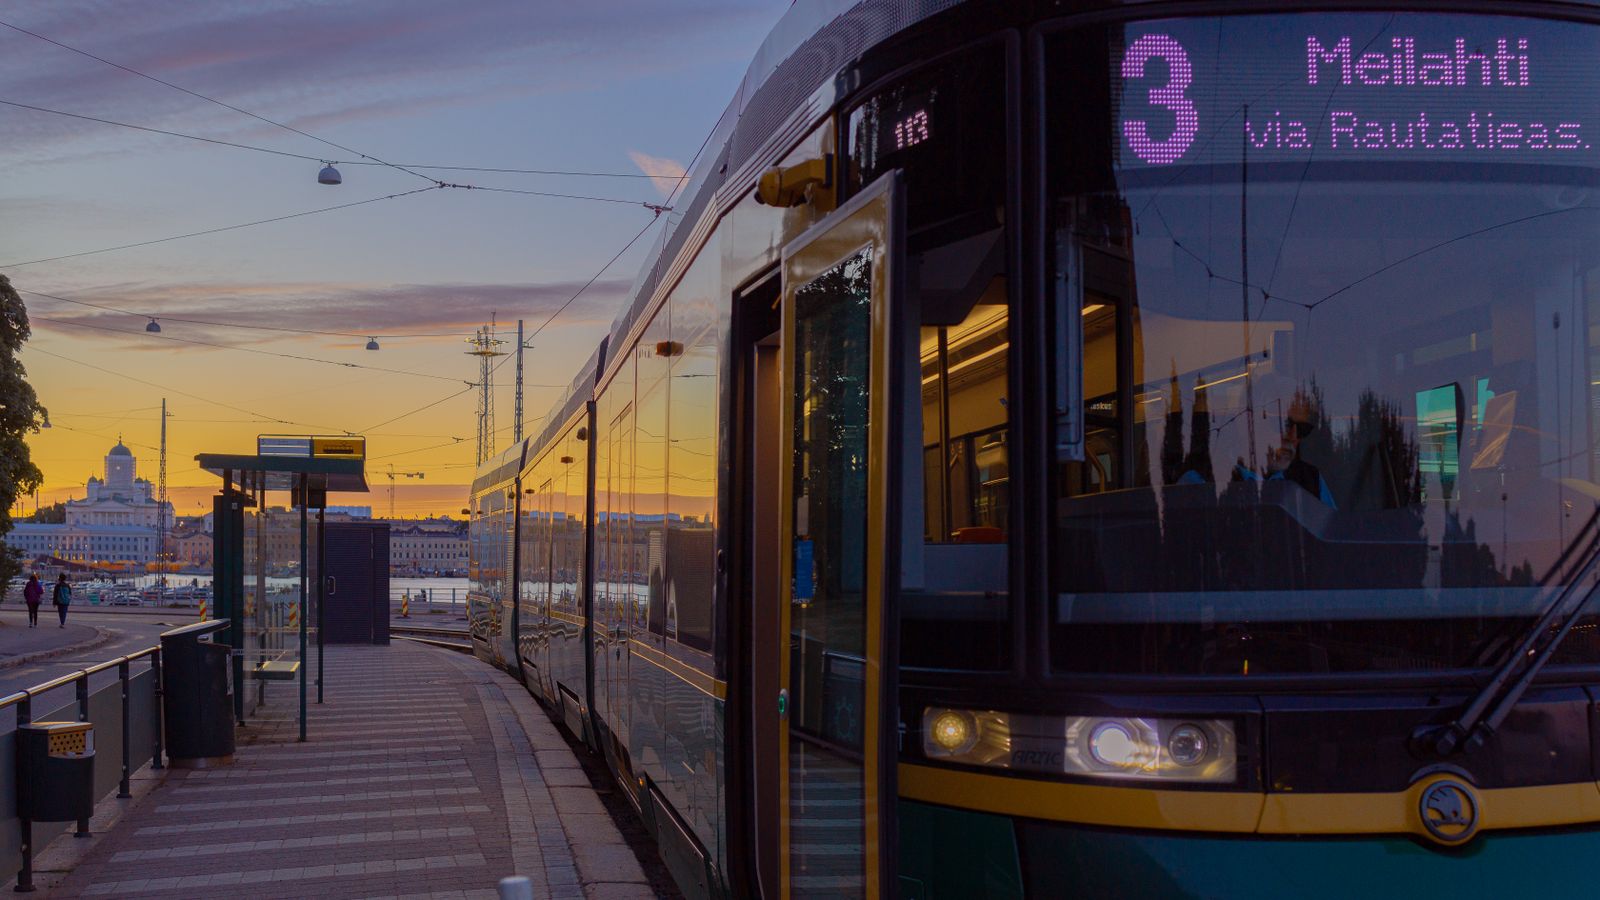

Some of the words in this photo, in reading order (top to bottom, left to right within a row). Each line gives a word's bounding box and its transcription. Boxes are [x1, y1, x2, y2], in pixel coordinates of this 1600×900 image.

[1306, 36, 1529, 86] Meilahti
[1121, 33, 1199, 164] 3
[895, 110, 929, 150] 113
[1244, 111, 1312, 149] via
[1330, 111, 1591, 150] Rautatieas.
